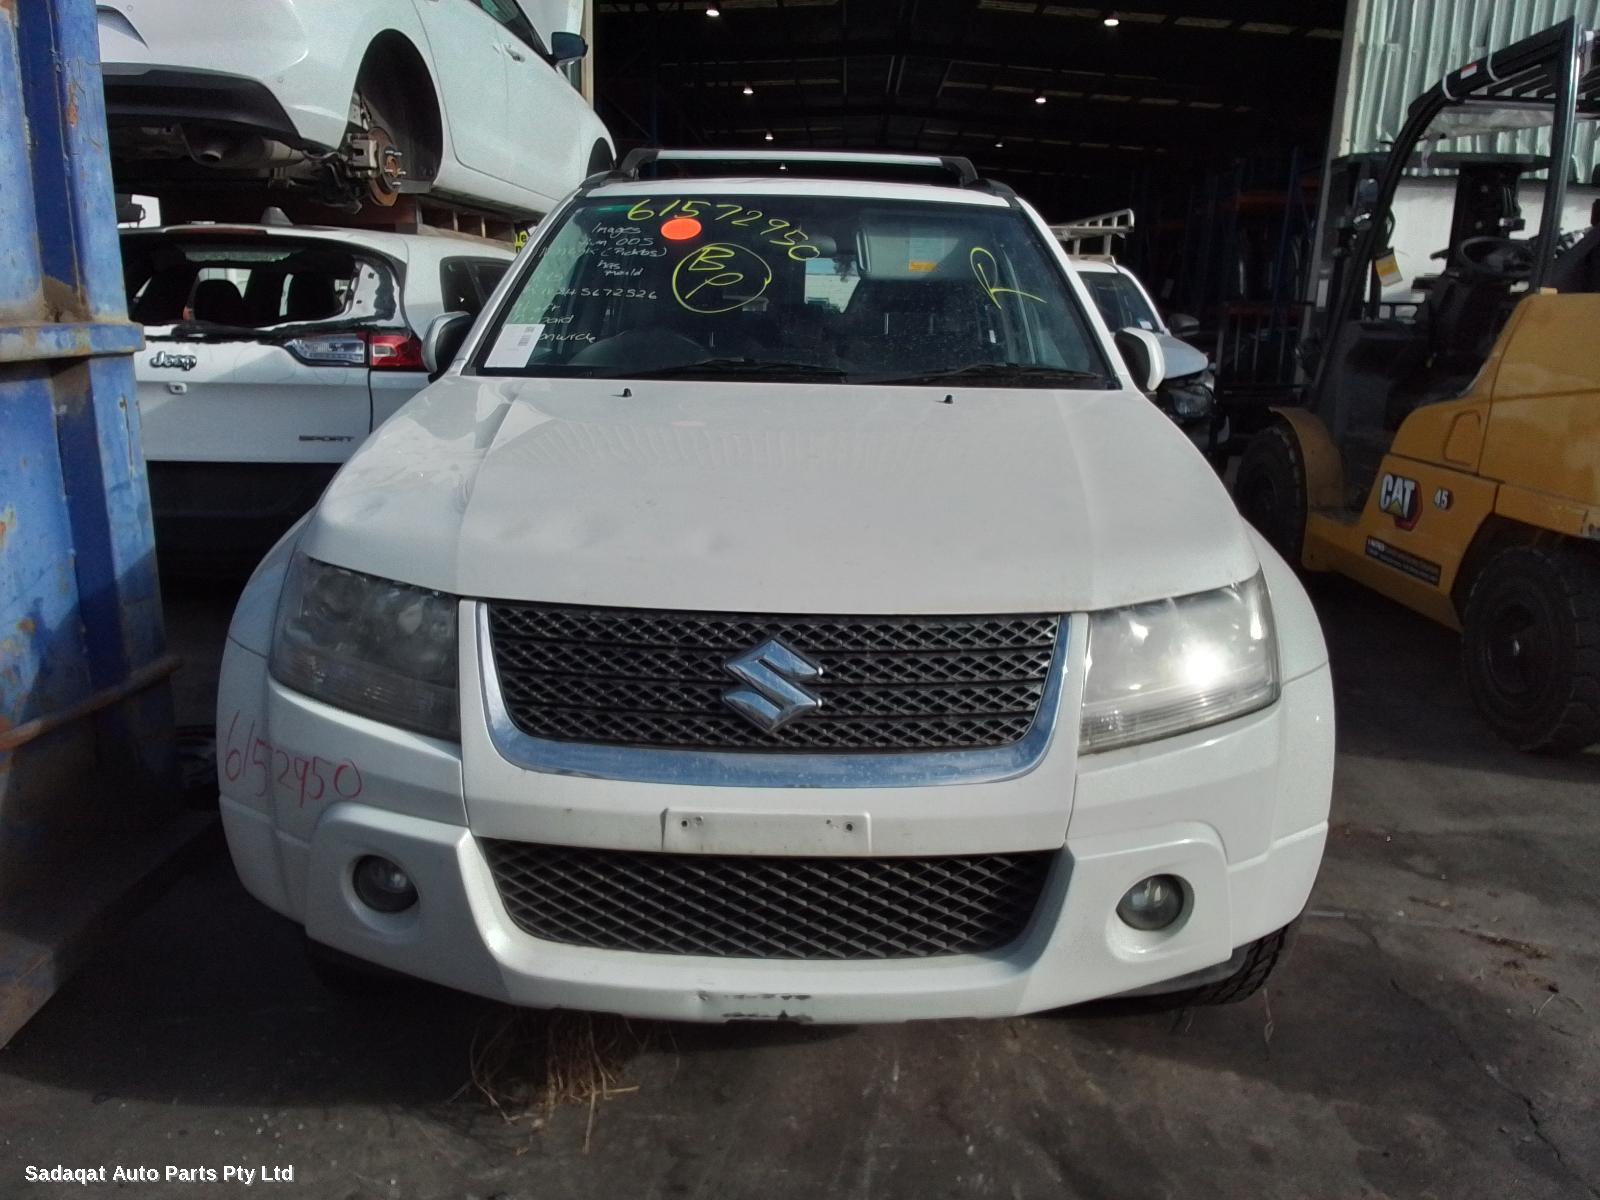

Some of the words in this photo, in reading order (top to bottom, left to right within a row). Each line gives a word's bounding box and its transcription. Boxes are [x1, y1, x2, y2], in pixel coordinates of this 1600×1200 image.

[627, 198, 821, 261] 61572950
[687, 246, 736, 272] B
[149, 350, 198, 371] Jeep
[298, 434, 355, 443] SPORT
[1380, 473, 1415, 519] CAT
[1434, 489, 1448, 509] 45
[224, 709, 364, 809] 6152950
